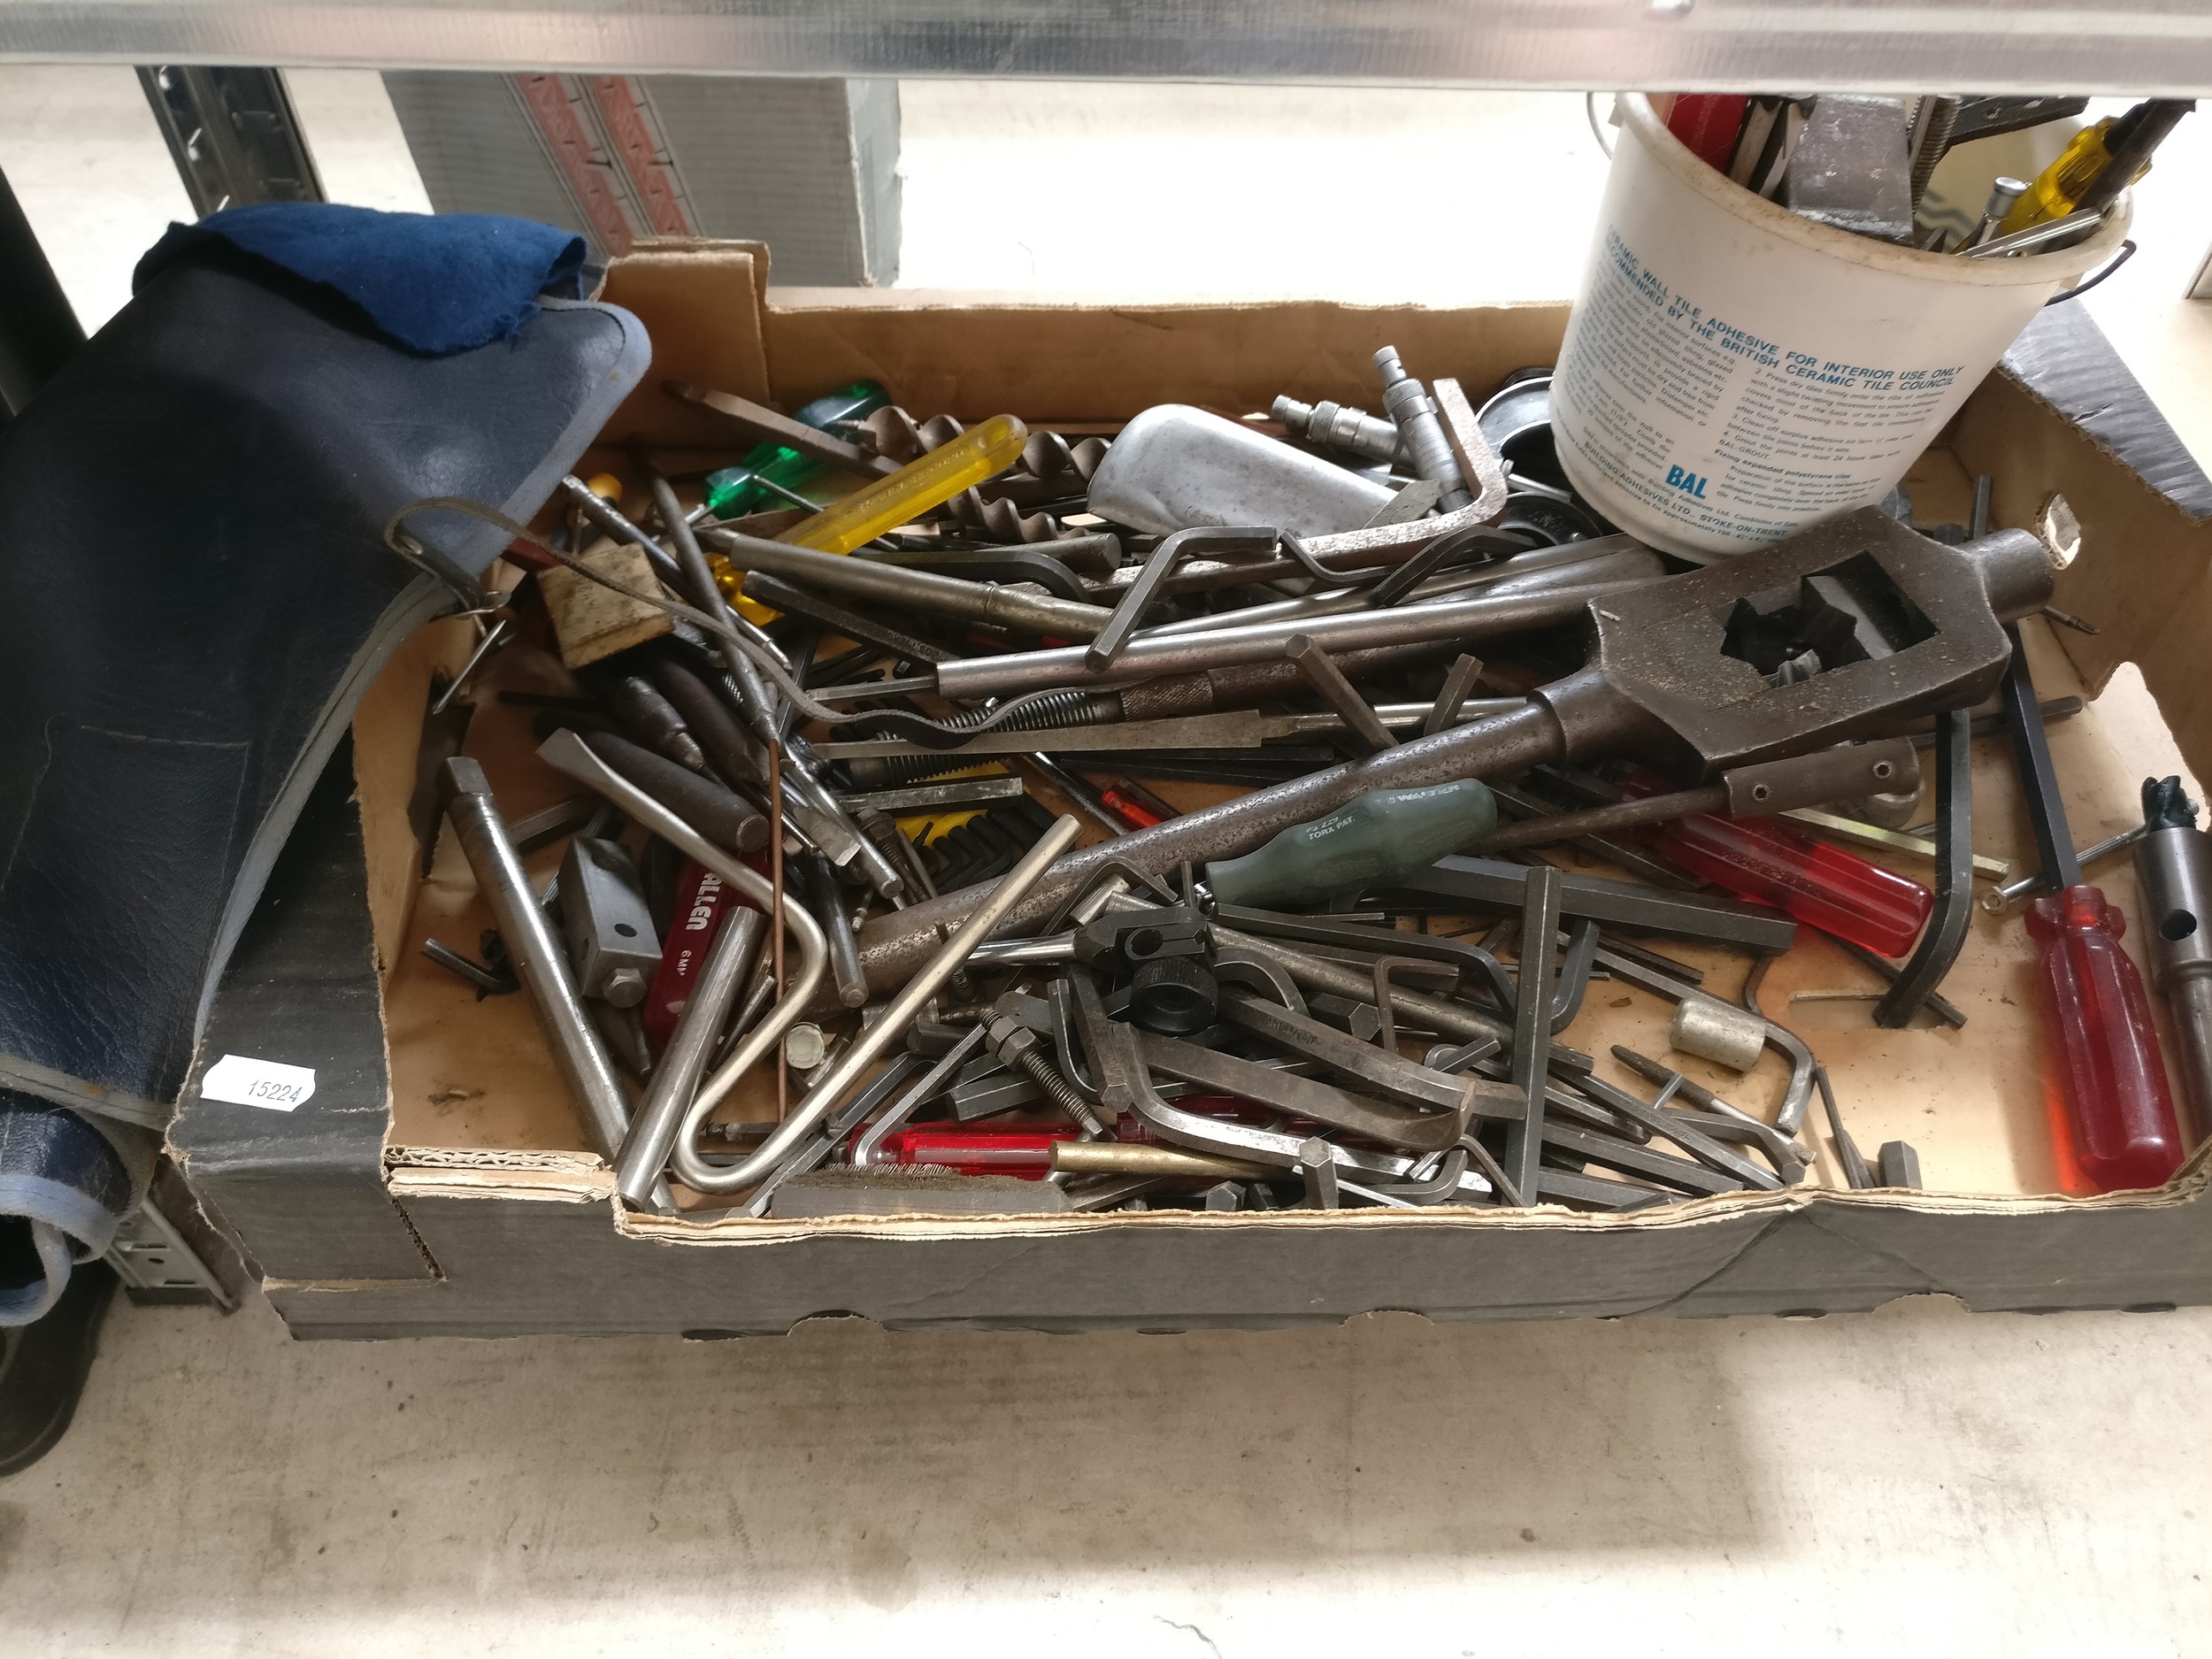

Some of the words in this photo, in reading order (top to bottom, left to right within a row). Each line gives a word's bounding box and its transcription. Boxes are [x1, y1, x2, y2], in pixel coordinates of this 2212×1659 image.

[1643, 268, 1670, 299] WALL
[1675, 295, 1702, 319] TILE
[1707, 318, 1779, 355] ADHESIVE
[1786, 350, 1817, 368] FOR
[1824, 361, 1894, 380] INTERIOR
[1900, 370, 1927, 380] USE
[1932, 365, 1965, 379] ONLY
[1667, 305, 1685, 320] BY
[1690, 319, 1716, 342] THE
[1720, 337, 1780, 368] BRITISH
[1786, 364, 1856, 388] CERAMIC
[1863, 380, 1894, 391] TILE
[1899, 376, 1954, 391] COUNCIL
[1691, 338, 1721, 357] surfaces
[1650, 346, 1686, 373] adequately
[1686, 370, 1713, 387] braced
[1713, 383, 1724, 392] by
[1663, 367, 1690, 387] provide
[1681, 357, 1713, 375] asbestos
[1708, 359, 1734, 373] glazed
[1668, 382, 1682, 393] and
[1682, 389, 1697, 401] free
[1698, 397, 1715, 410] from
[1750, 378, 1769, 388] with
[1777, 388, 1801, 398] slight
[1801, 395, 1834, 407] twisting
[1766, 372, 1788, 384] Press
[1789, 380, 1804, 389] dry
[1805, 384, 1824, 394] tiles
[1824, 389, 1848, 399] firmly
[1655, 396, 1694, 421] information
[1745, 388, 1772, 401] covers
[1775, 397, 1796, 407] most
[1735, 404, 1755, 415] after
[1740, 396, 1775, 411] checked
[1793, 412, 1832, 426] removing
[1726, 422, 1761, 437] between
[1741, 416, 1765, 428] Clean
[1780, 429, 1809, 441] surplus
[1734, 434, 1757, 446] Grout
[1774, 448, 1798, 457] joints
[1714, 449, 1740, 463] Fixing
[1742, 459, 1785, 473] expanded
[1785, 470, 1832, 480] polystyrene
[1730, 465, 1771, 481] Preparation
[1585, 440, 1619, 475] BUILDING
[1619, 472, 1670, 506] ADHESIVES
[1699, 514, 1787, 537] STOKE-ON-TRENT
[1665, 464, 1708, 500] BAL
[1720, 483, 1752, 495] adhesive
[1754, 493, 1793, 503] completely
[1739, 479, 1768, 489] ceramic
[1647, 478, 1676, 497] Building
[1678, 494, 1714, 512] Adhesives
[1733, 513, 1772, 526] Conditions
[1733, 495, 1753, 504] Press
[1663, 510, 1716, 533] approximately
[1337, 816, 1356, 830] PAT.
[248, 1079, 303, 1103] 15224
